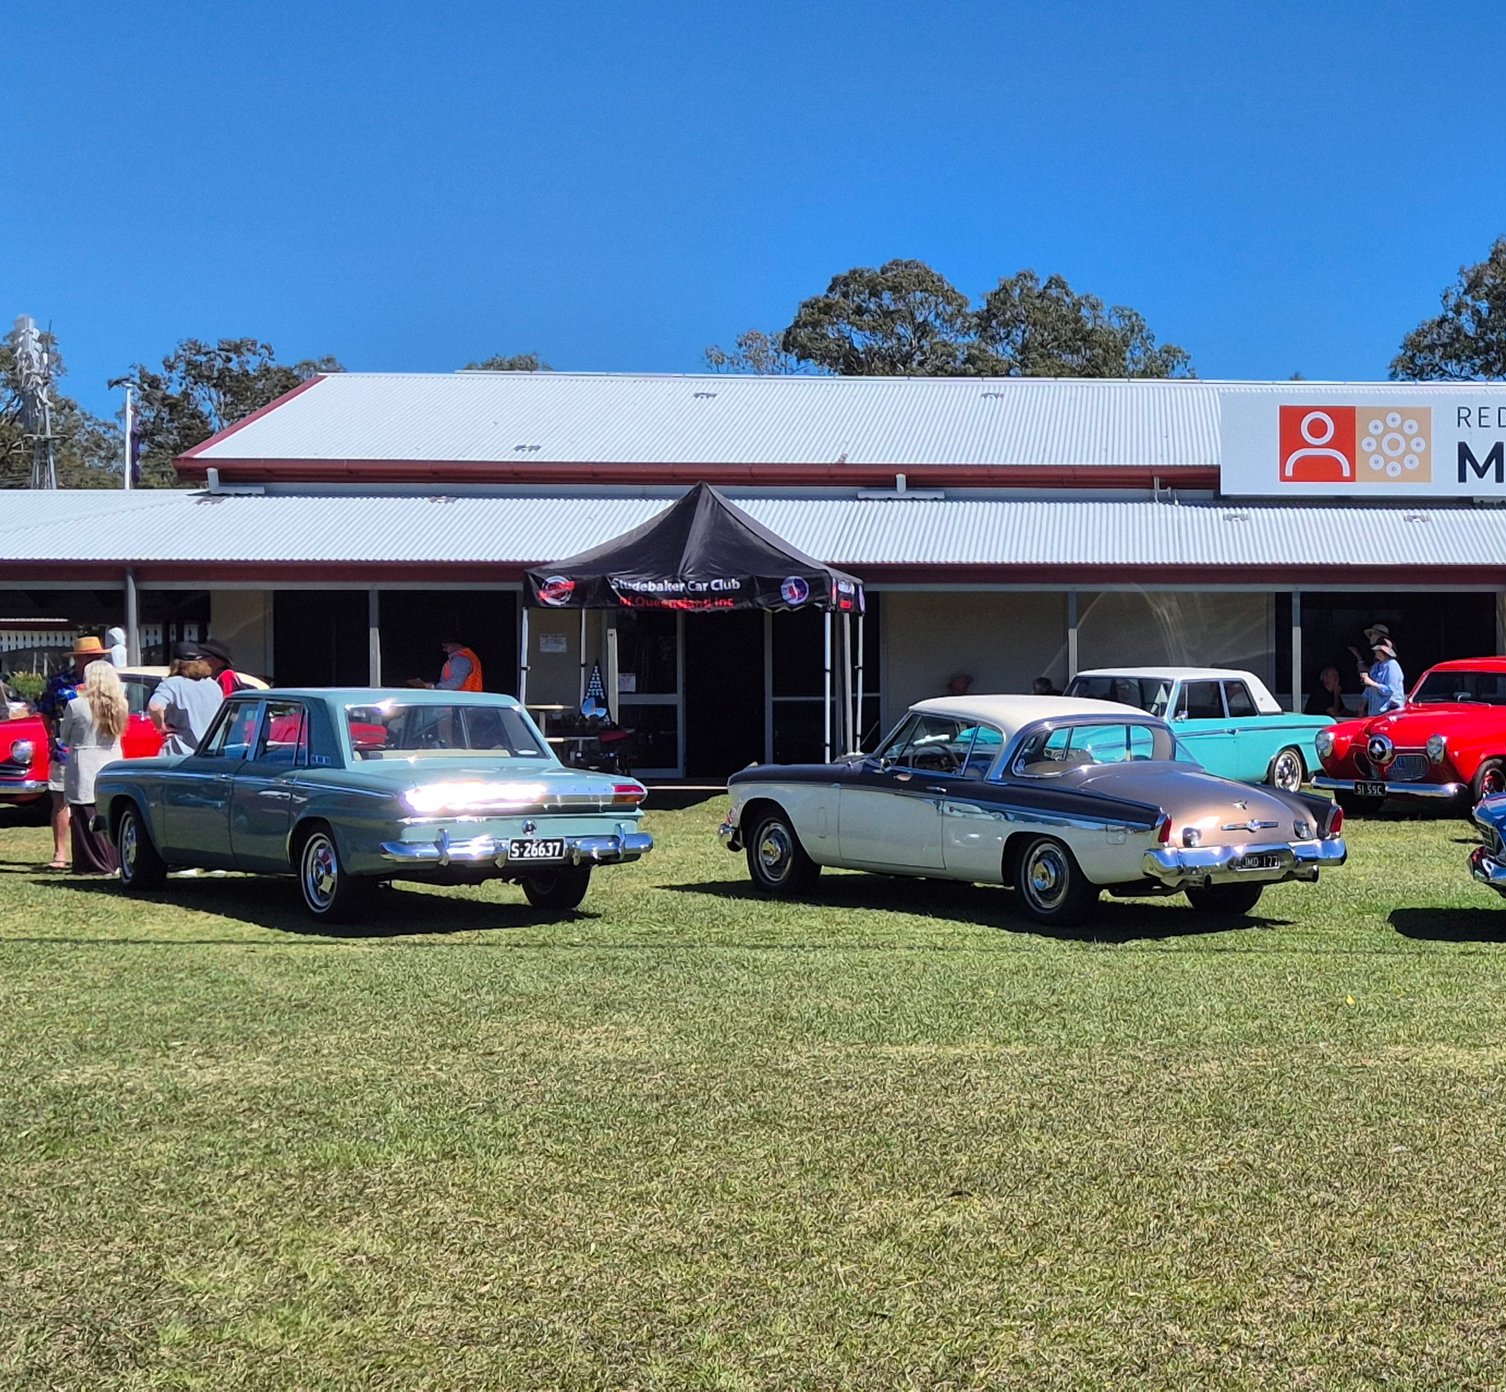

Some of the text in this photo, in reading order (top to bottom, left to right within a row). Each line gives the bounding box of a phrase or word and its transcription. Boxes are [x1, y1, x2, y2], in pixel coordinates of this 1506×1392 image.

[612, 578, 741, 592] Studebaker Car Club
